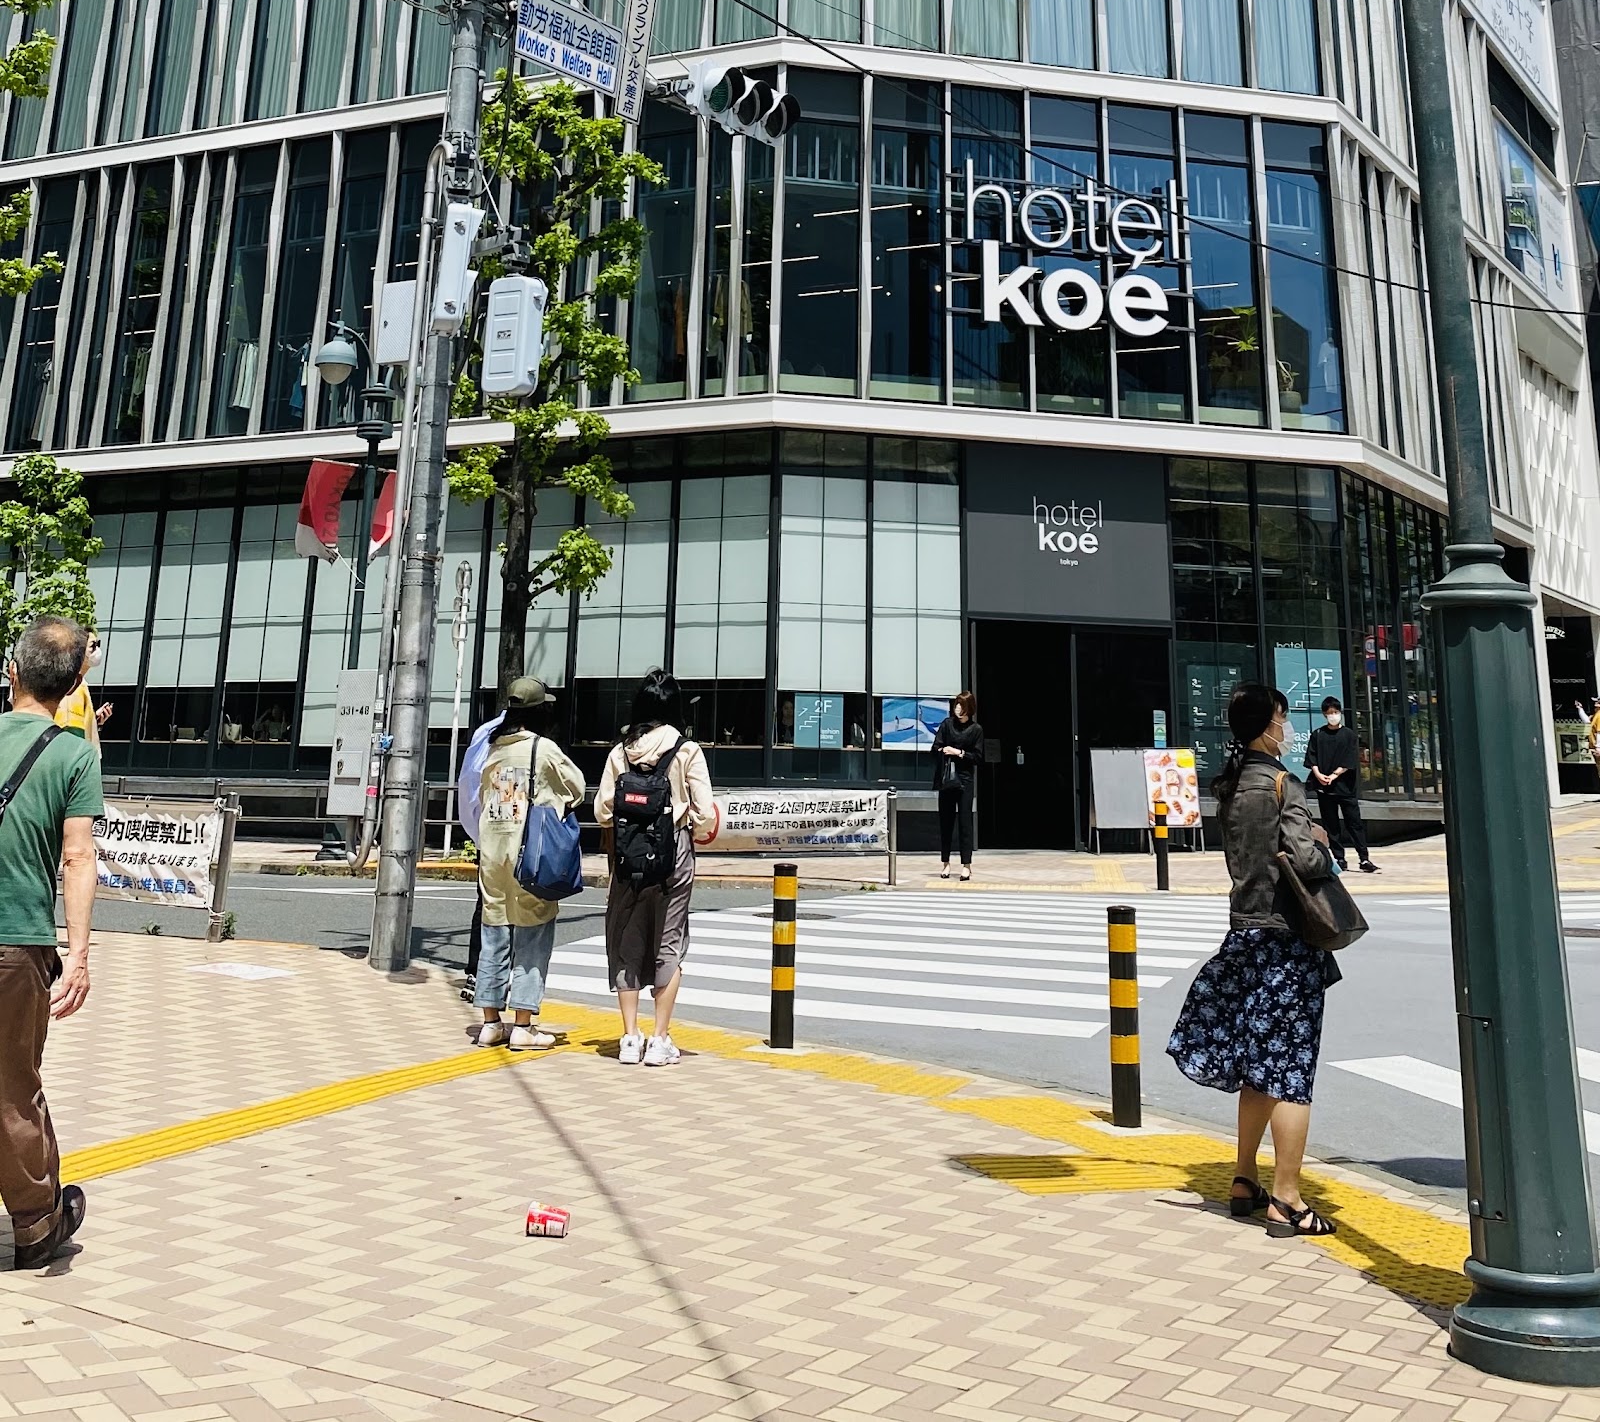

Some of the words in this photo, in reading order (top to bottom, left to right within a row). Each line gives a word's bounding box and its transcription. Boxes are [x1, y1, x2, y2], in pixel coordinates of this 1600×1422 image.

[517, 27, 556, 63] Worker's
[561, 46, 592, 78] Welfare
[597, 62, 613, 87] Hall
[966, 158, 1180, 261] hotel
[1033, 495, 1103, 528] hotel
[1059, 558, 1079, 567] tokyo
[1308, 668, 1333, 688] 2F
[814, 699, 833, 714] 2F
[94, 848, 199, 868] 過料の対象となります。
[97, 873, 197, 895] 地区美化推進委員会
